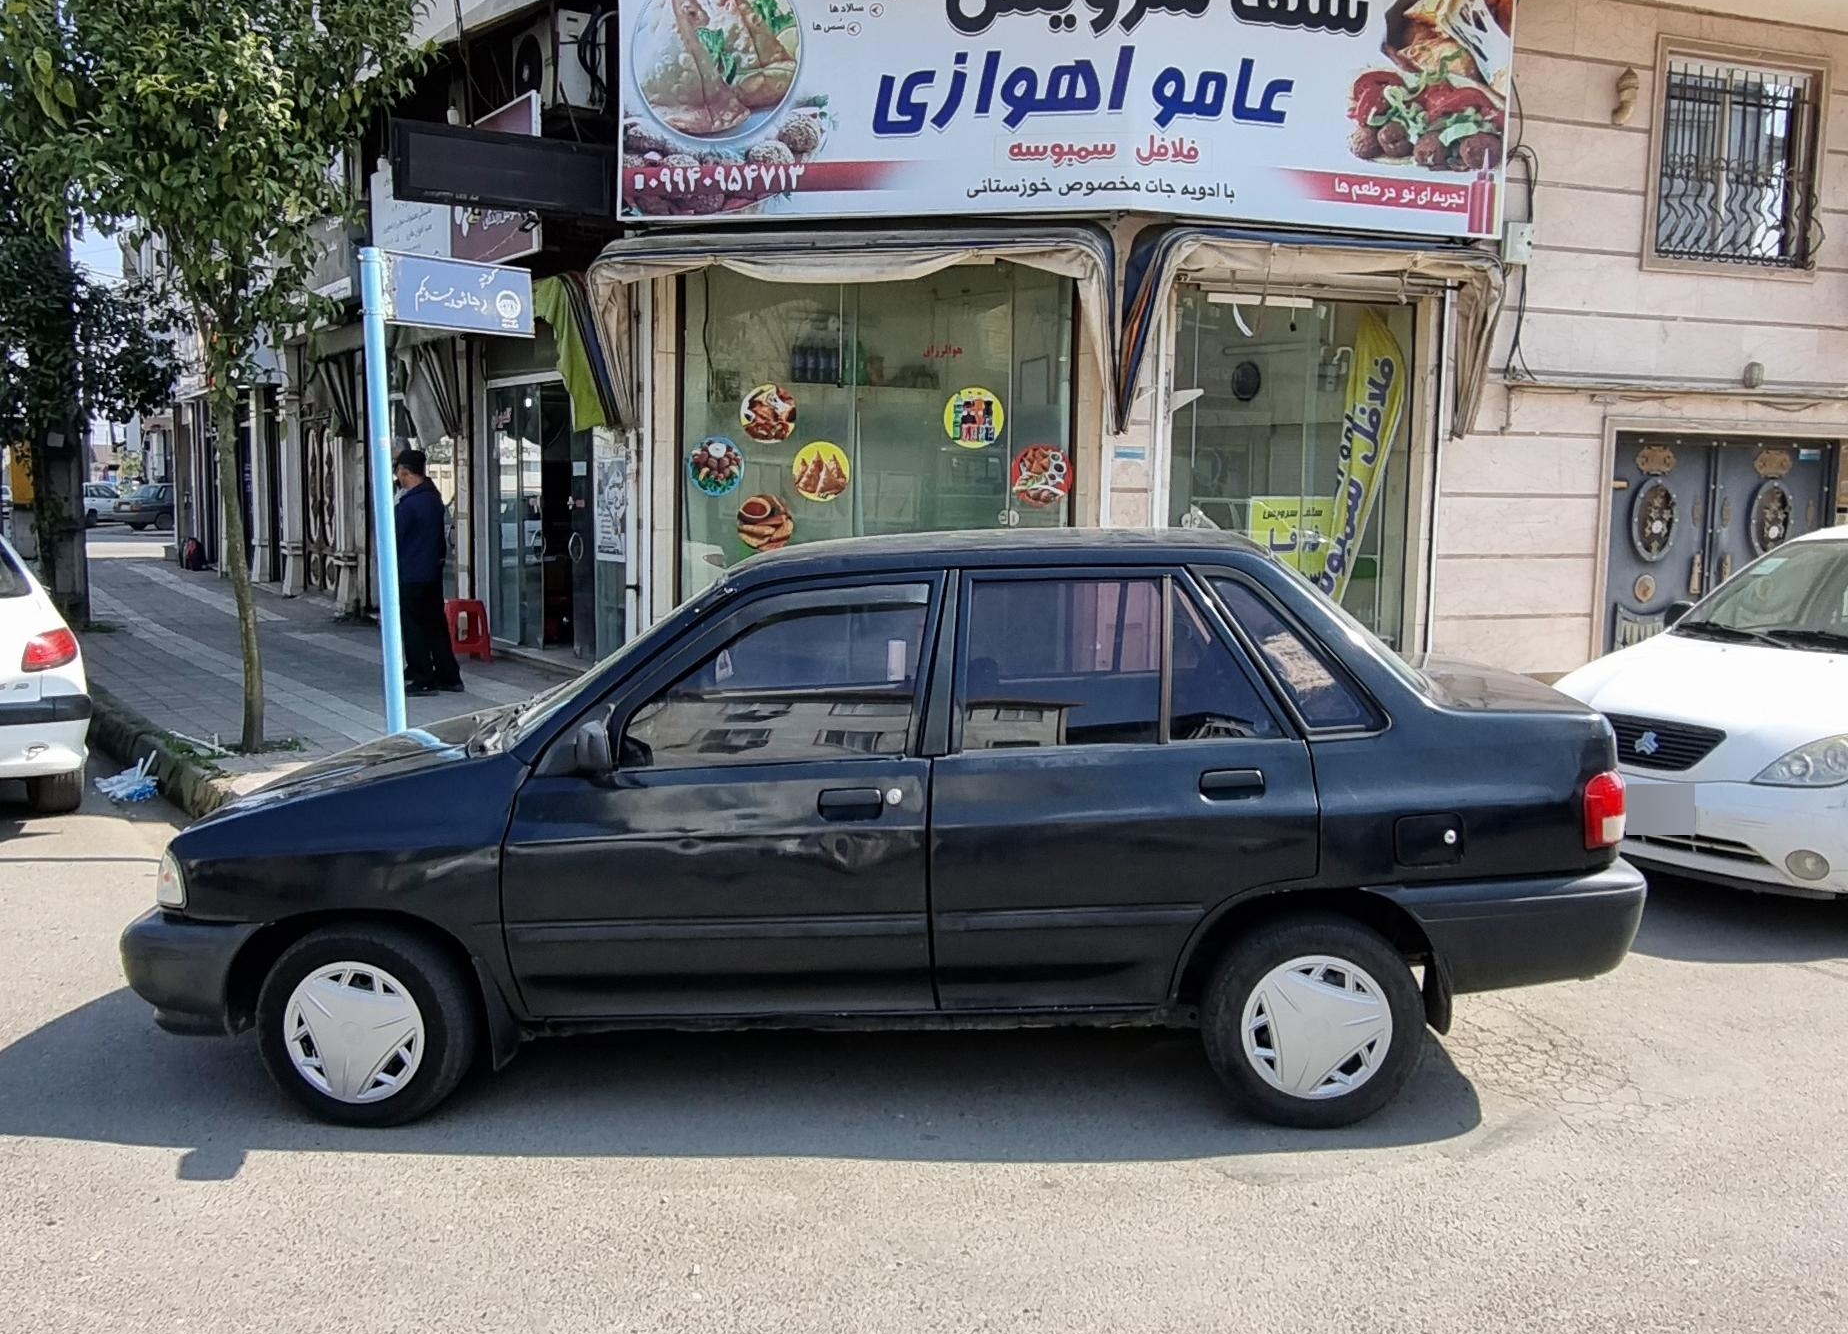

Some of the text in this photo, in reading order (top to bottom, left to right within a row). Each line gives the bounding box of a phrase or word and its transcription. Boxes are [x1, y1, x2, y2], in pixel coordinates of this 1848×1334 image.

[872, 45, 1294, 135] عامو اهوازی
[1008, 134, 1200, 166] فلافل سمبوسه
[966, 177, 1235, 203] با ادویه جات مخصوص خوزستانی
[1334, 177, 1465, 207] تجربه ای نو در طعم ها
[1352, 356, 1395, 466] فلافل
